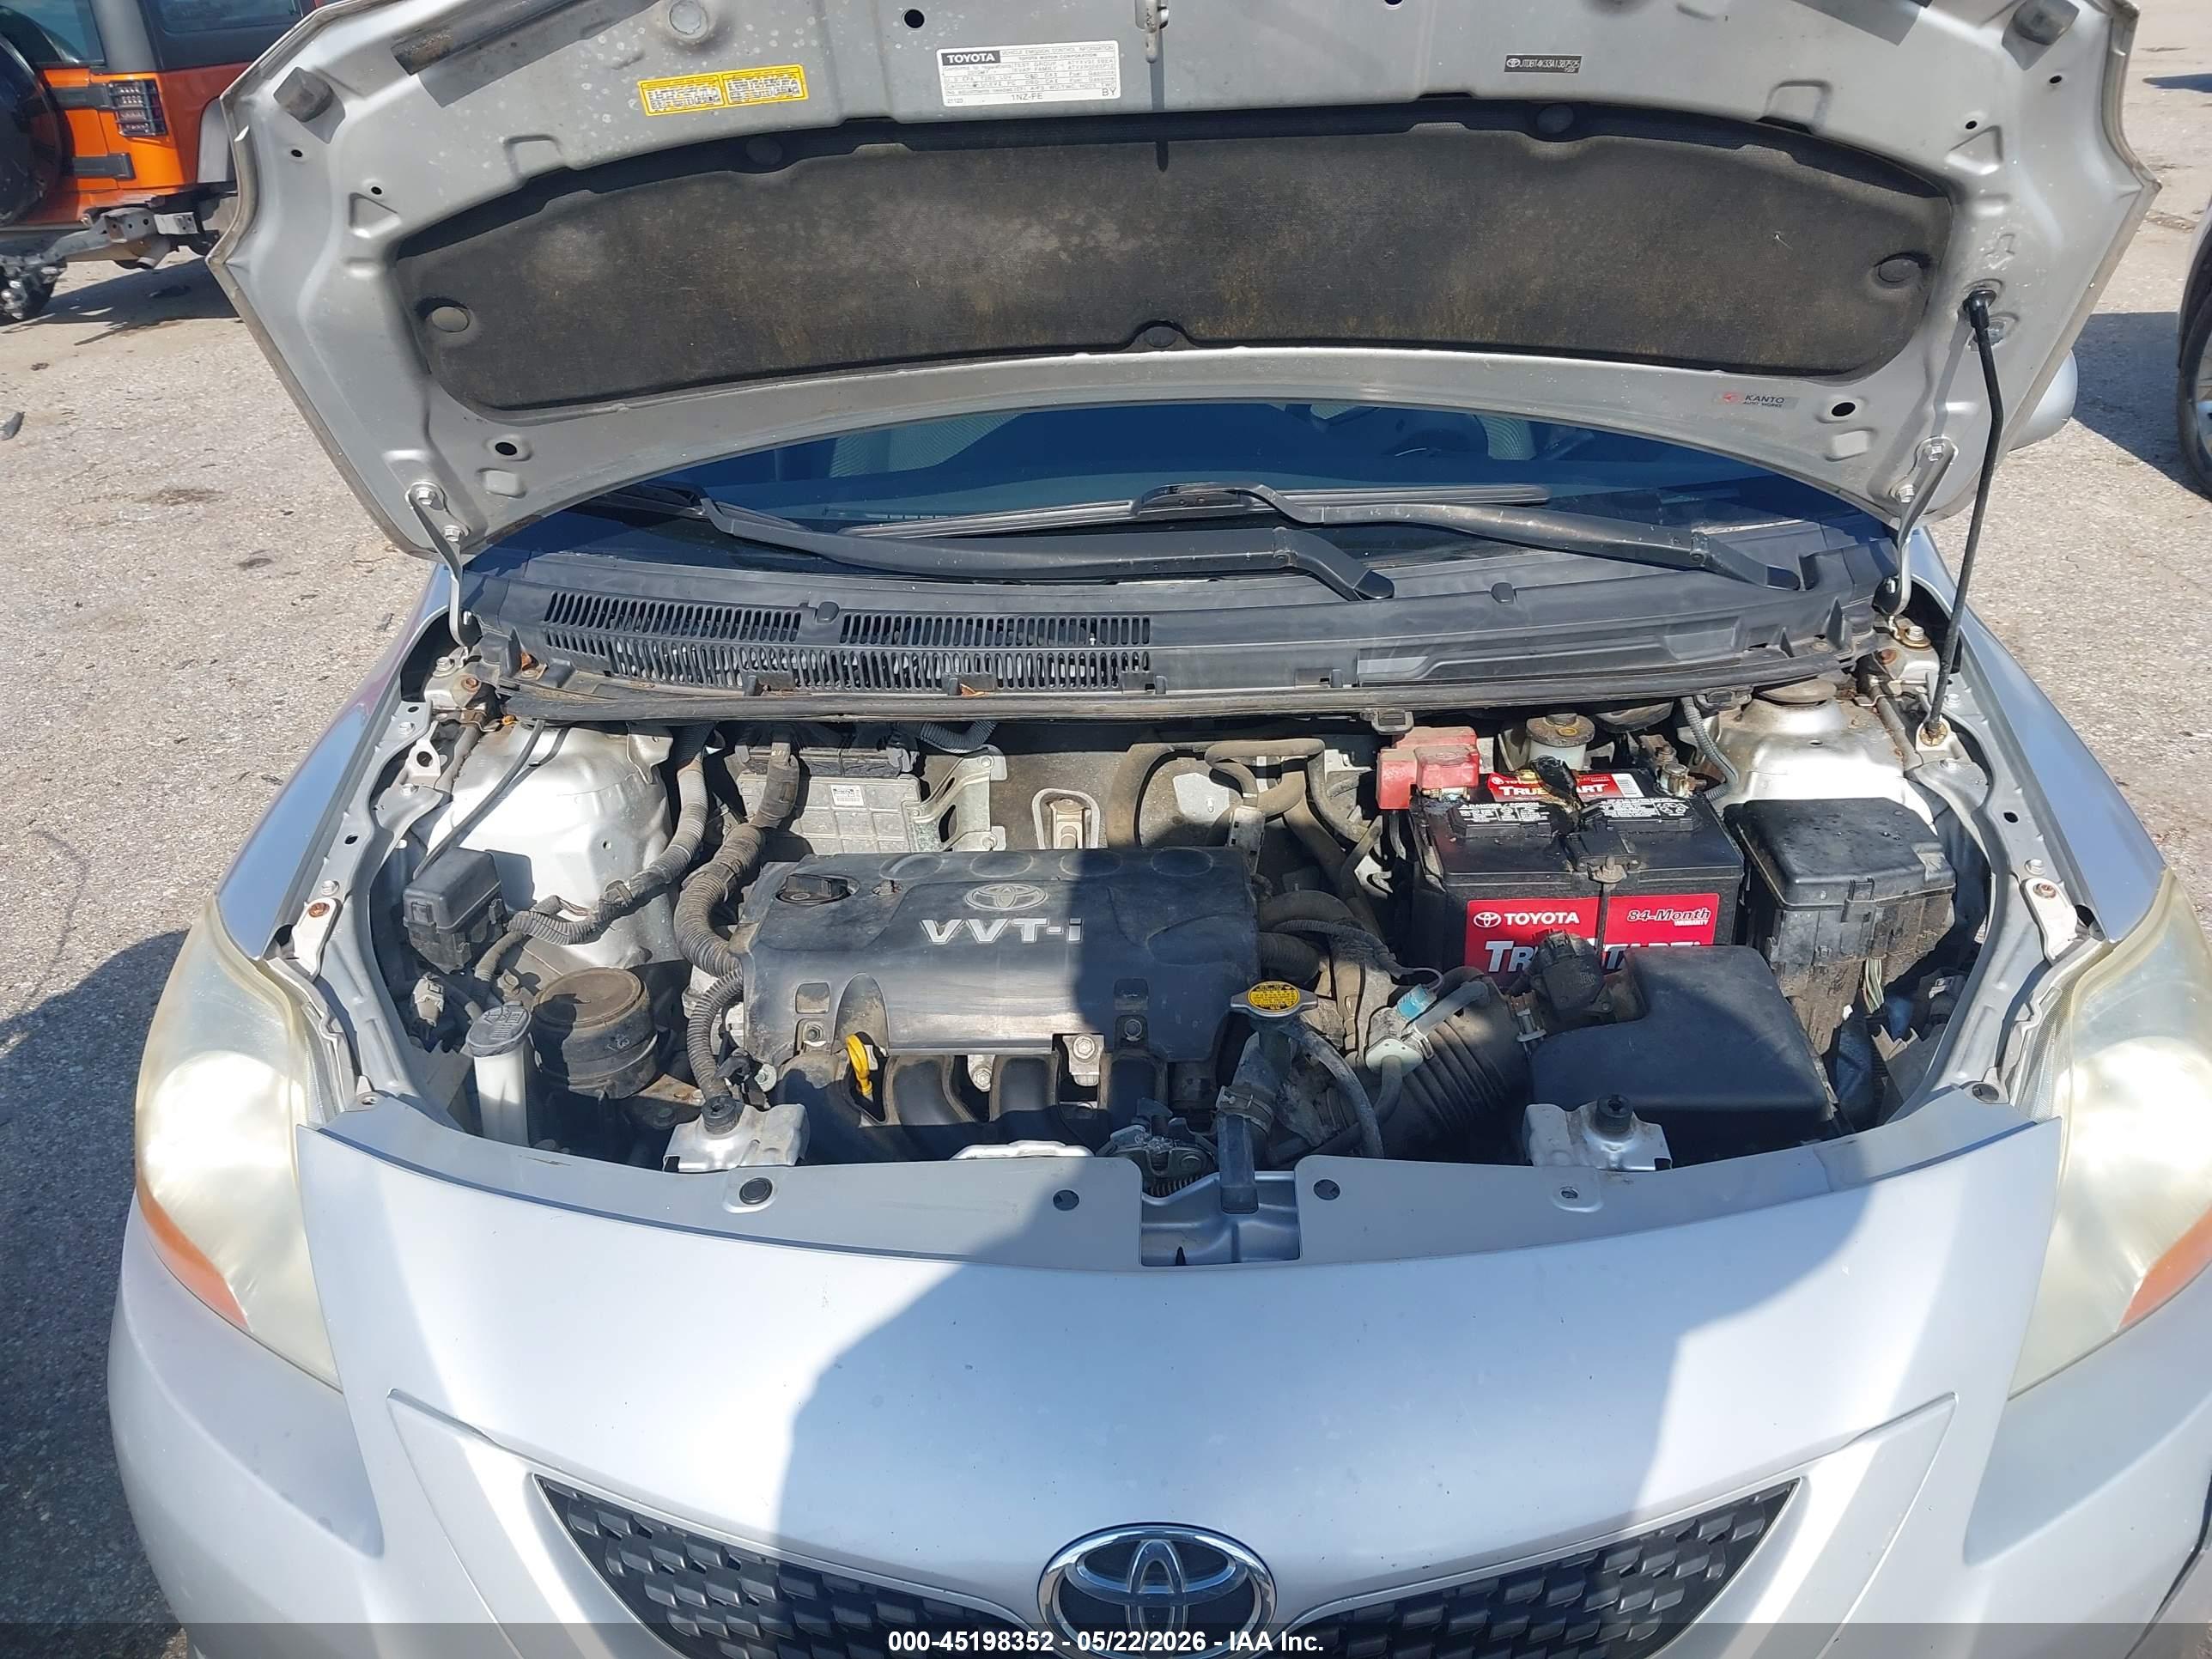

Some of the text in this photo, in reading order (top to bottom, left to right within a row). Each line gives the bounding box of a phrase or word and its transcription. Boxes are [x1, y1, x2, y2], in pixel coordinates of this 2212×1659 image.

[947, 52, 994, 63] TOYOTA
[1011, 92, 1042, 100] 1NZ-FE
[1102, 88, 1115, 96] BY
[1745, 395, 1785, 404] KANTO
[1504, 907, 1711, 925] TOYOTA 84-Month
[921, 917, 1084, 945] VVT-i
